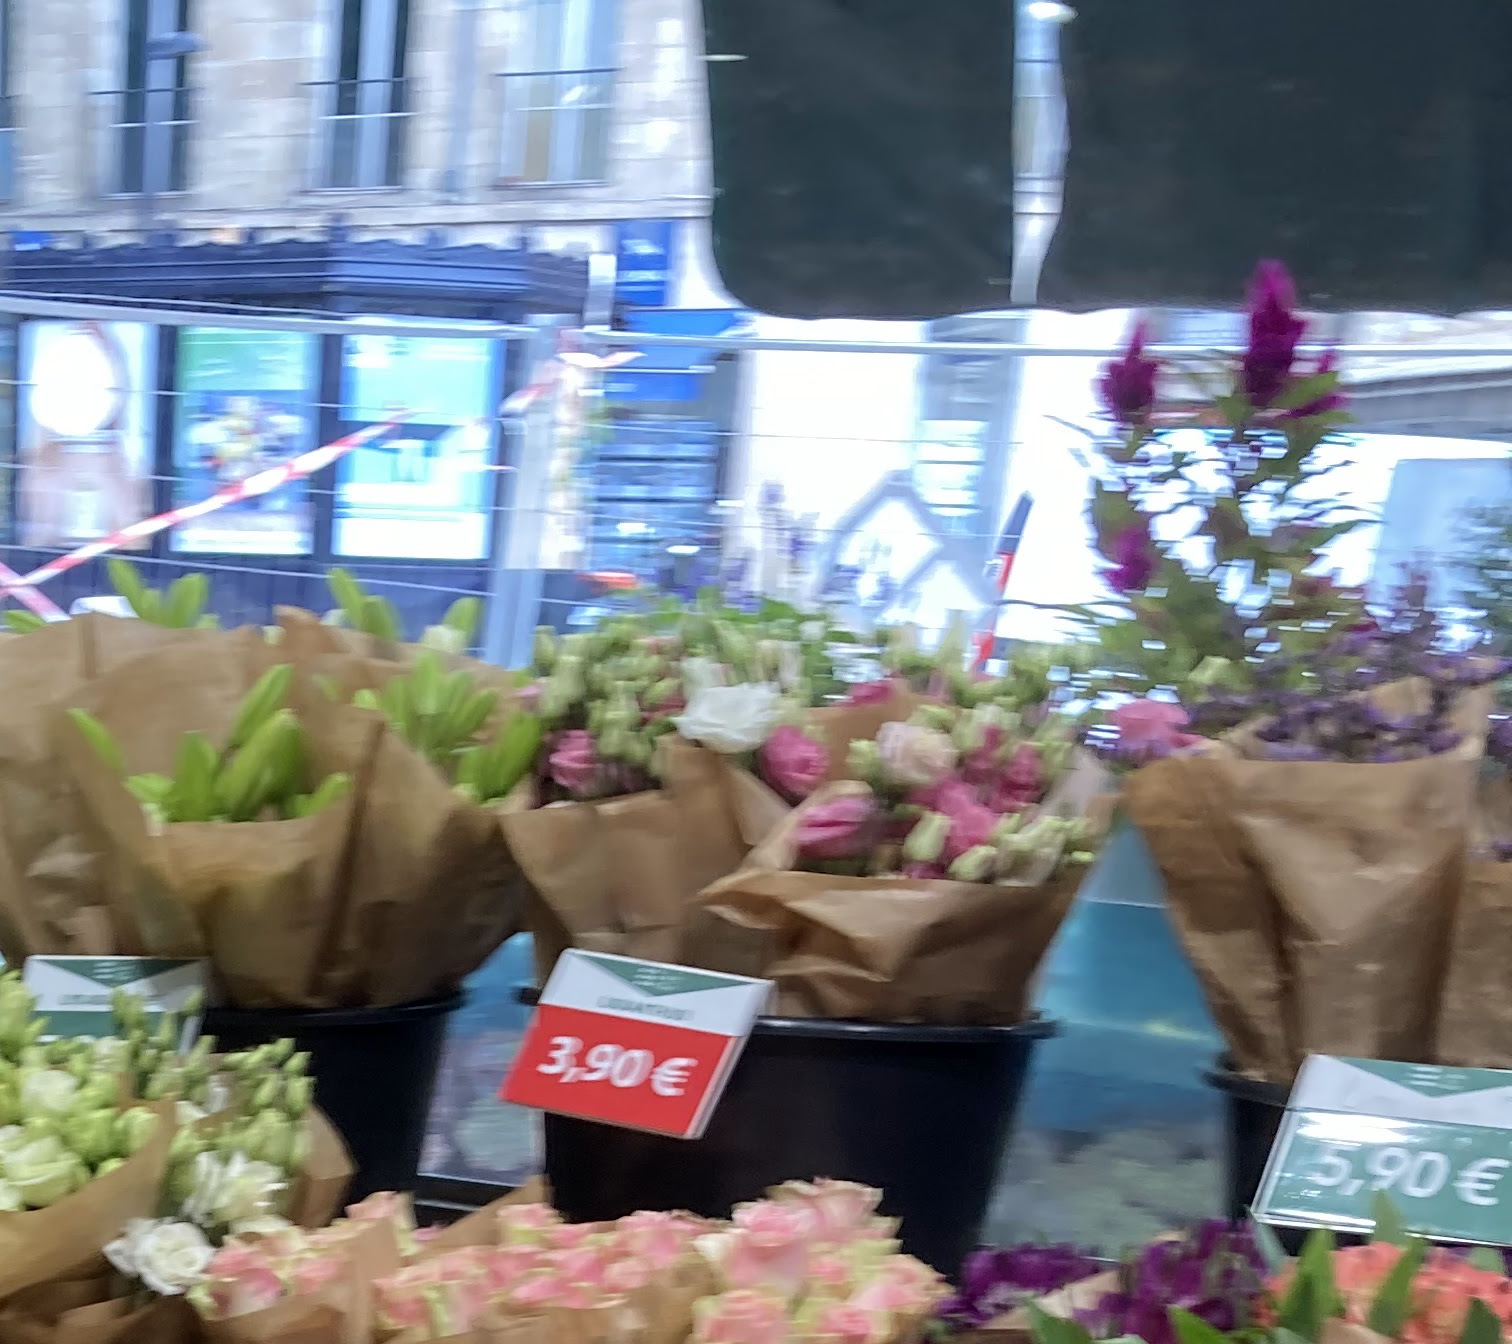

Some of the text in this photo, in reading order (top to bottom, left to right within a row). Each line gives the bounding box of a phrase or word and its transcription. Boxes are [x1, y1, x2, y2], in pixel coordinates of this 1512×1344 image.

[536, 1035, 699, 1098] 3,90 €
[1310, 1143, 1512, 1207] 5,90 €
